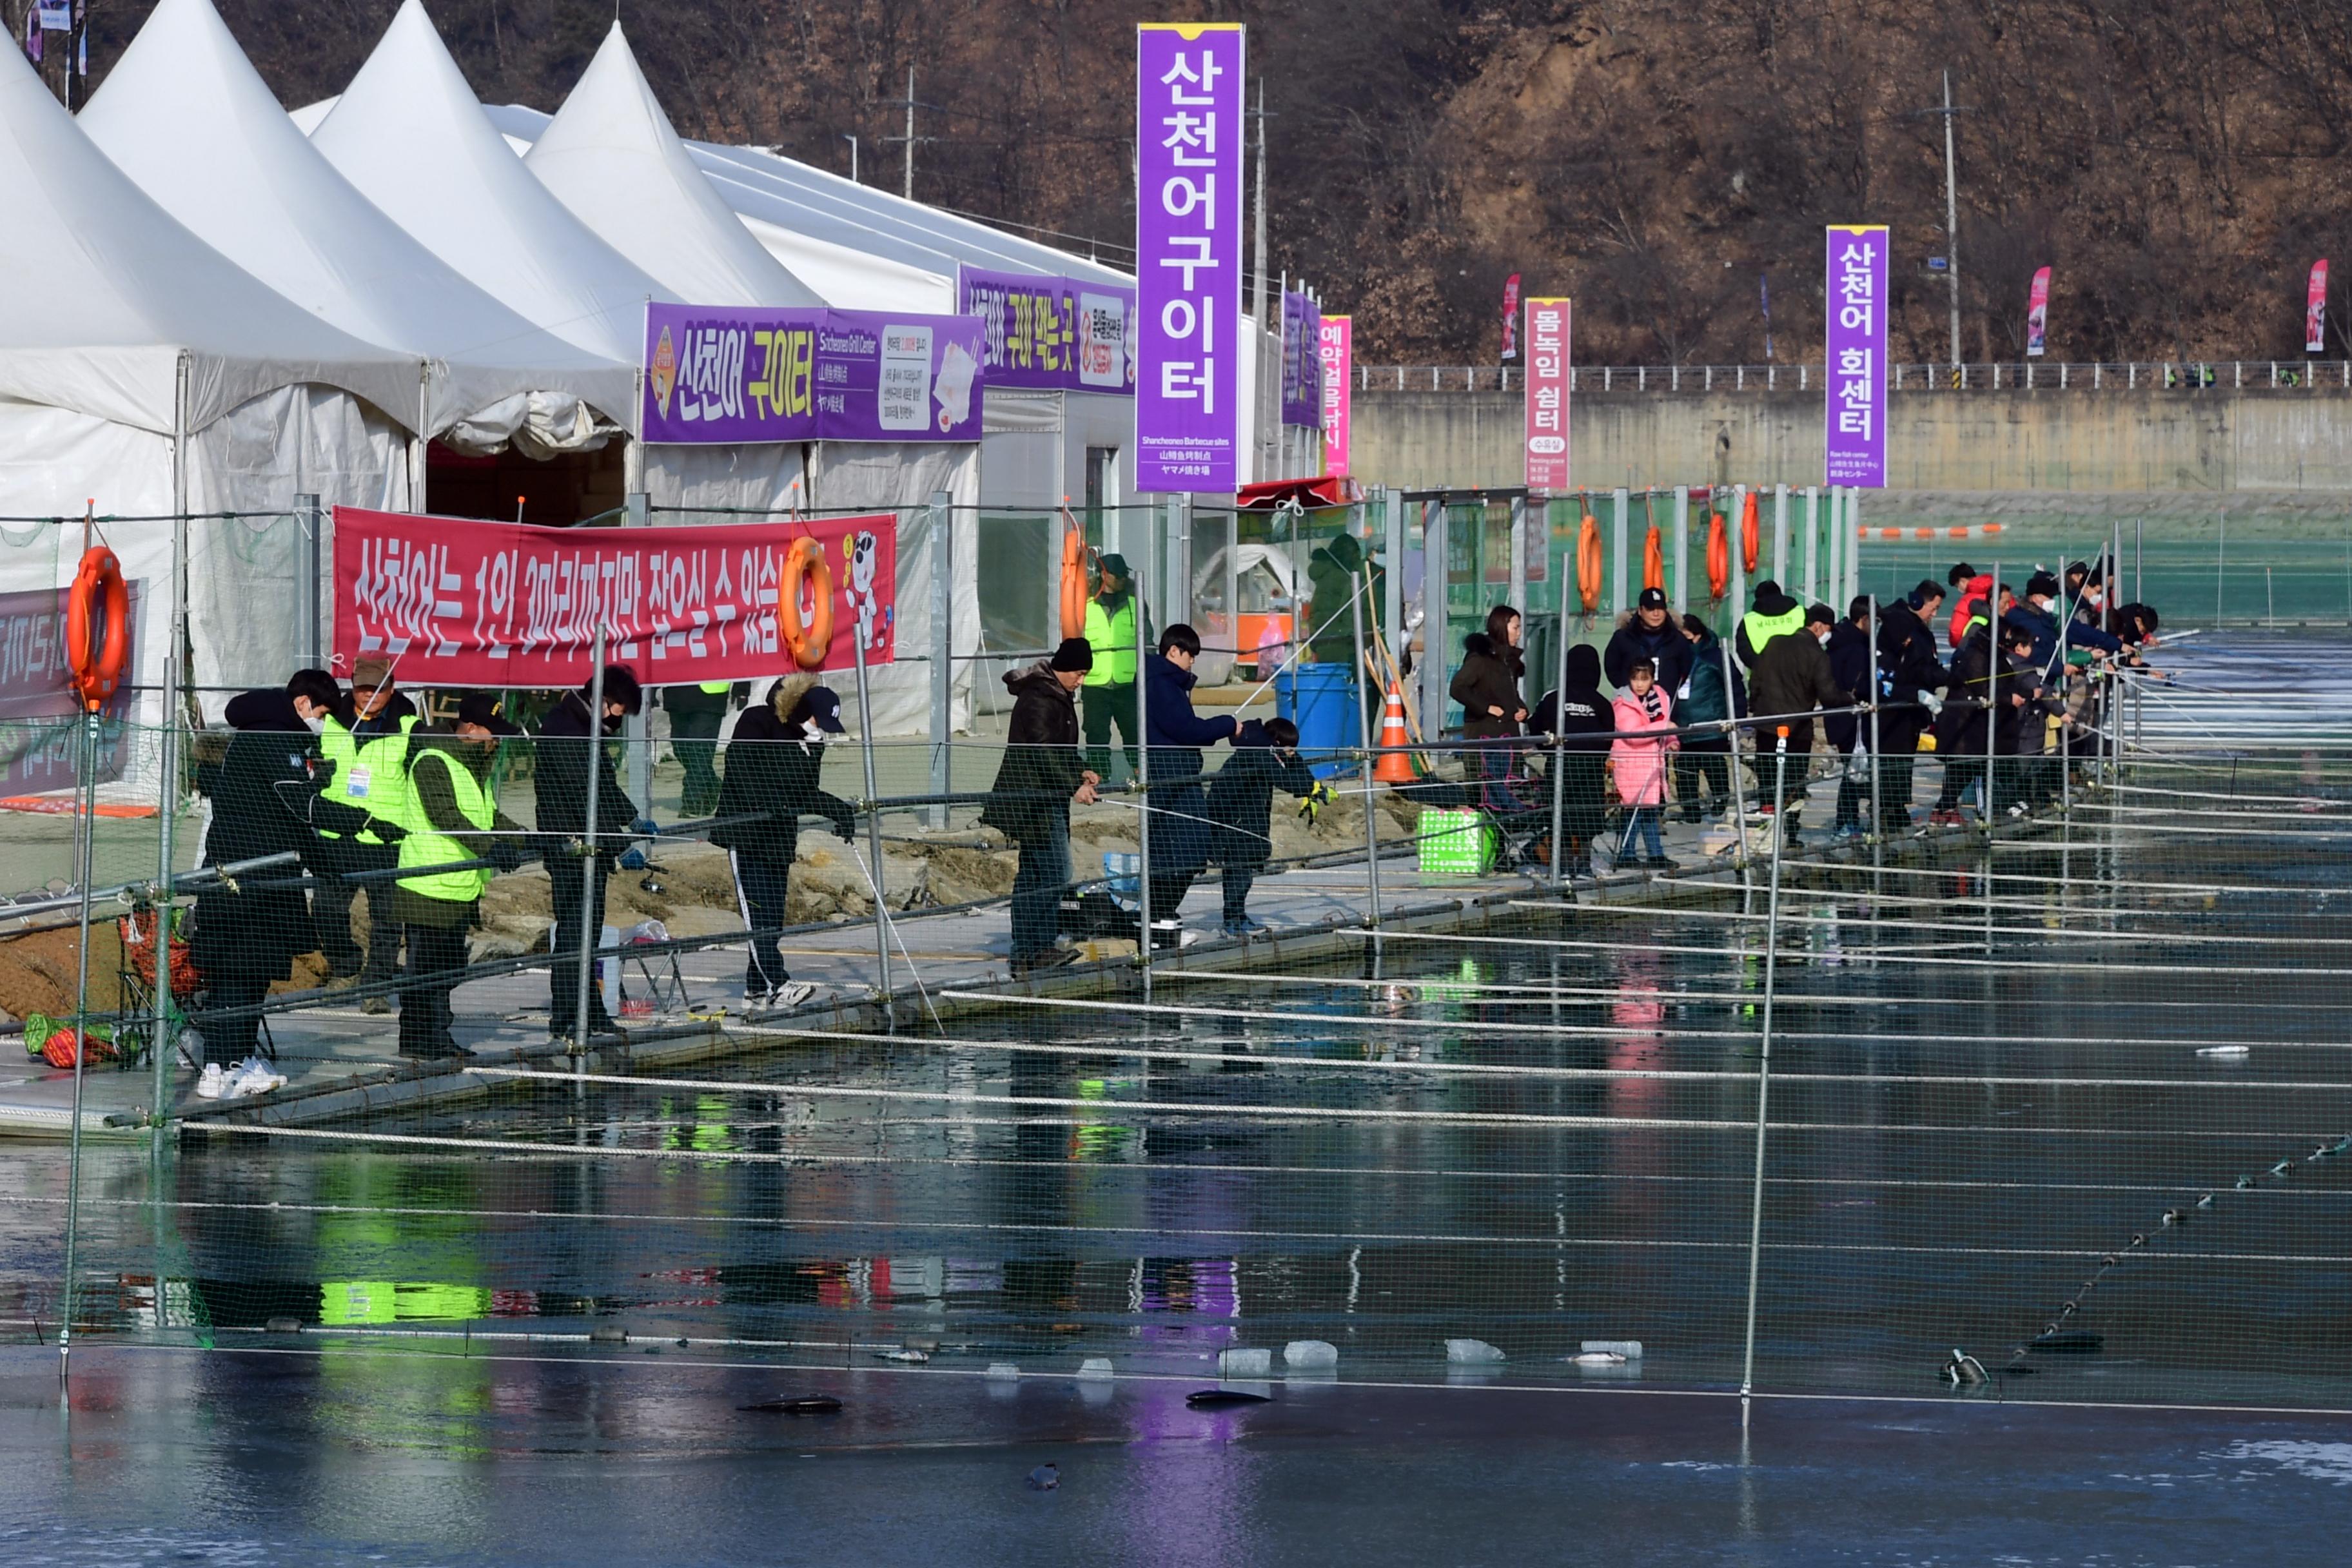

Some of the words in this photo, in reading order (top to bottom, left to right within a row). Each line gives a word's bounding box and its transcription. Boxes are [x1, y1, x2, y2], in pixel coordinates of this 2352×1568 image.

[1160, 50, 1223, 415] 산천어구이터
[677, 328, 747, 422] 산천어
[748, 329, 814, 420] 구이터
[1007, 293, 1032, 369] 구이
[1184, 437, 1213, 446] Barbecue
[1214, 438, 1230, 446] sites
[355, 536, 463, 658] 산천어는
[473, 549, 518, 659] 1인
[518, 549, 642, 662] 3마리까지만
[648, 548, 710, 660] 잡으실
[714, 548, 737, 658] 수
